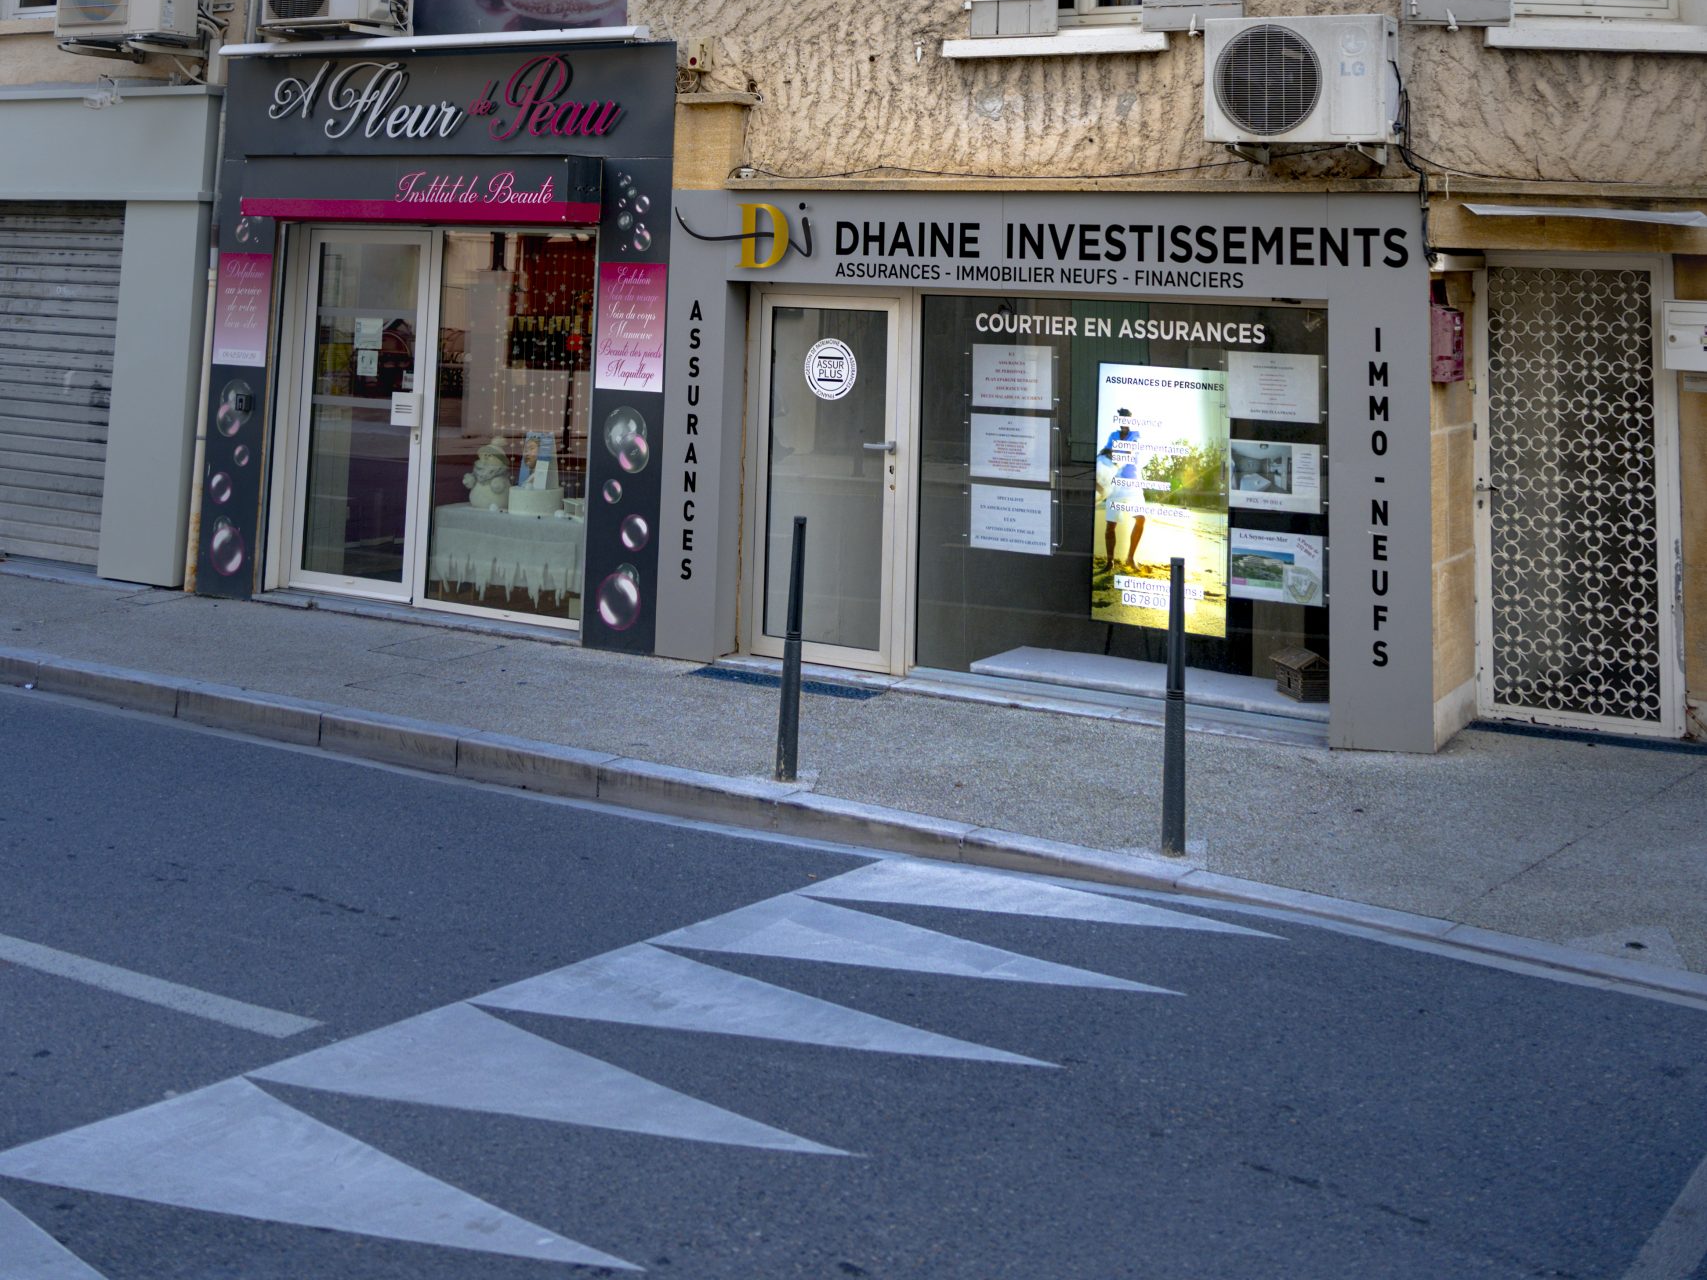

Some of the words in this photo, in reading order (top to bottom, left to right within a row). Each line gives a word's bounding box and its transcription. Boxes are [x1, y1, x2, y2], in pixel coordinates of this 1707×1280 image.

[1340, 61, 1365, 76] LG
[269, 60, 330, 119] A
[325, 61, 462, 139] Fleur
[467, 79, 489, 116] de
[489, 52, 622, 140] Peau
[395, 171, 464, 203] Institut
[458, 175, 479, 203] de
[484, 171, 554, 204] Beauté
[835, 221, 981, 259] DHAINE
[1005, 222, 1409, 269] INVESTISSEMENTS
[834, 262, 941, 280] ASSURANCES
[956, 265, 1055, 284] IMMOBILIER
[1060, 268, 1118, 285] NEUFS
[1134, 270, 1244, 289] FINANCIERS
[606, 301, 622, 320] Soin
[625, 304, 635, 320] du
[636, 312, 657, 329] corps
[975, 312, 1078, 337] COURTIER
[1084, 317, 1112, 338] EN
[1118, 319, 1266, 345] ASSURANCES
[608, 320, 653, 340] Manucure
[629, 342, 642, 358] des
[641, 343, 663, 365] pieds
[816, 359, 845, 370] ASSUR
[605, 359, 655, 388] Maquillage
[818, 369, 843, 379] PLUS
[1105, 376, 1160, 388] ASSURANCES
[1161, 380, 1172, 388] DE
[1174, 381, 1225, 392] PERSONNES
[1368, 327, 1389, 457] IMMO
[680, 299, 703, 580] ASSURANCES
[1110, 476, 1156, 489] Assurance
[1157, 482, 1171, 491] vie
[1109, 501, 1156, 515] Assurance
[1370, 499, 1389, 668] NEUFS
[1123, 592, 1137, 604] 06
[1138, 594, 1151, 606] 78
[1152, 596, 1167, 608] 00
